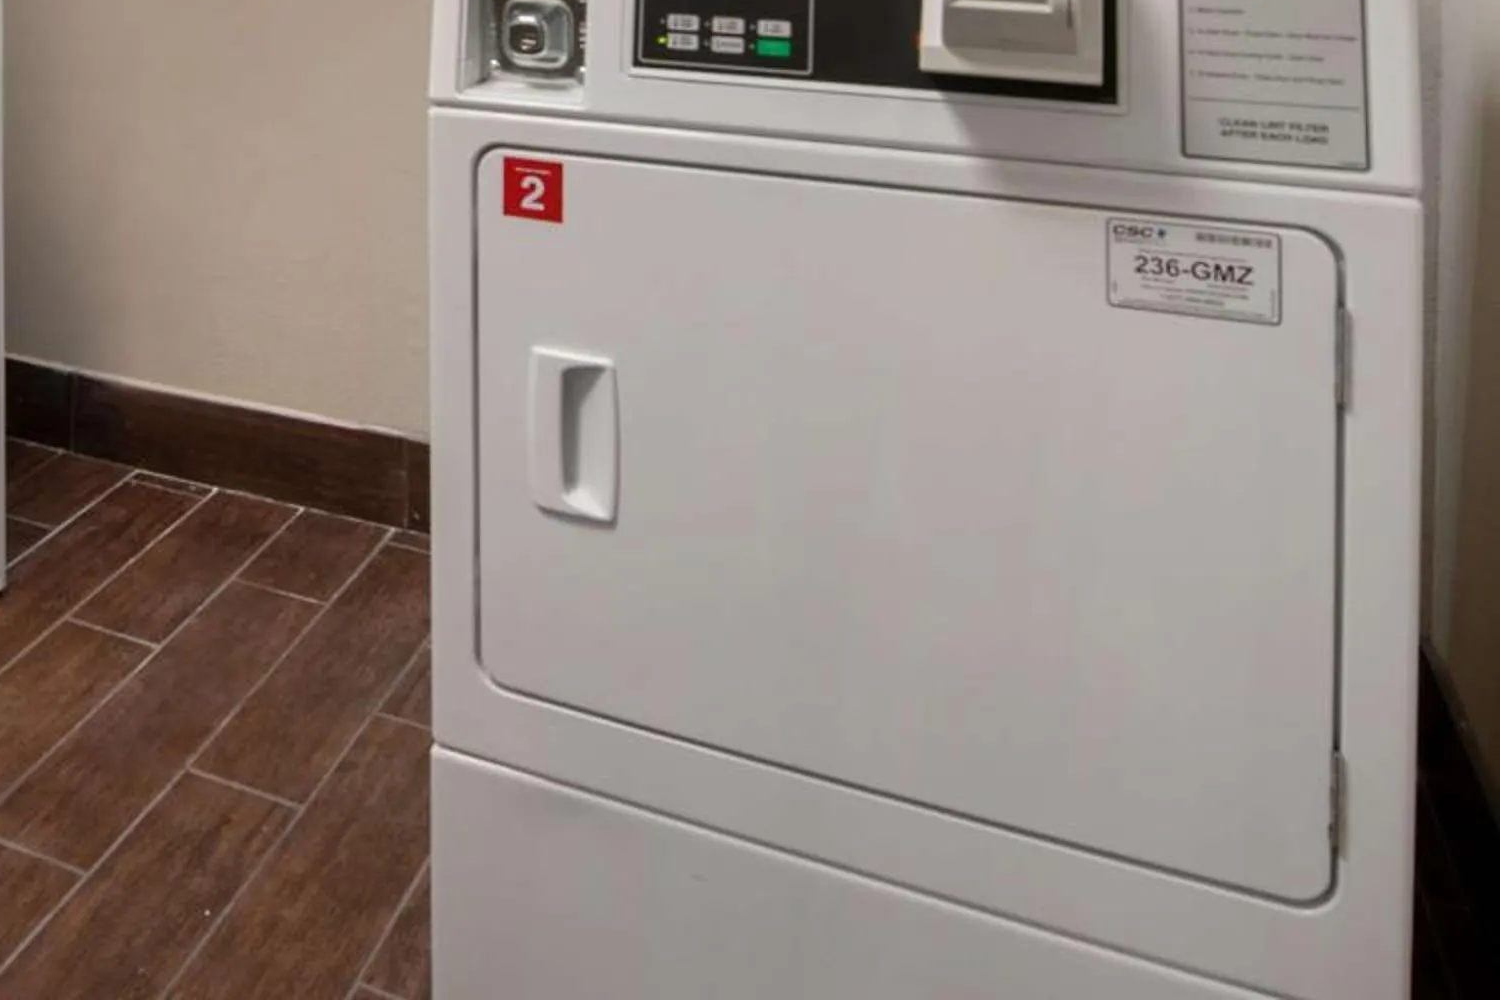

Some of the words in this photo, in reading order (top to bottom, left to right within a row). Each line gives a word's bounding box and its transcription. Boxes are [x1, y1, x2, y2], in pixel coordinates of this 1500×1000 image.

[520, 175, 546, 211] 2
[1112, 224, 1154, 239] CSC
[1134, 254, 1255, 286] 236-GMZ
